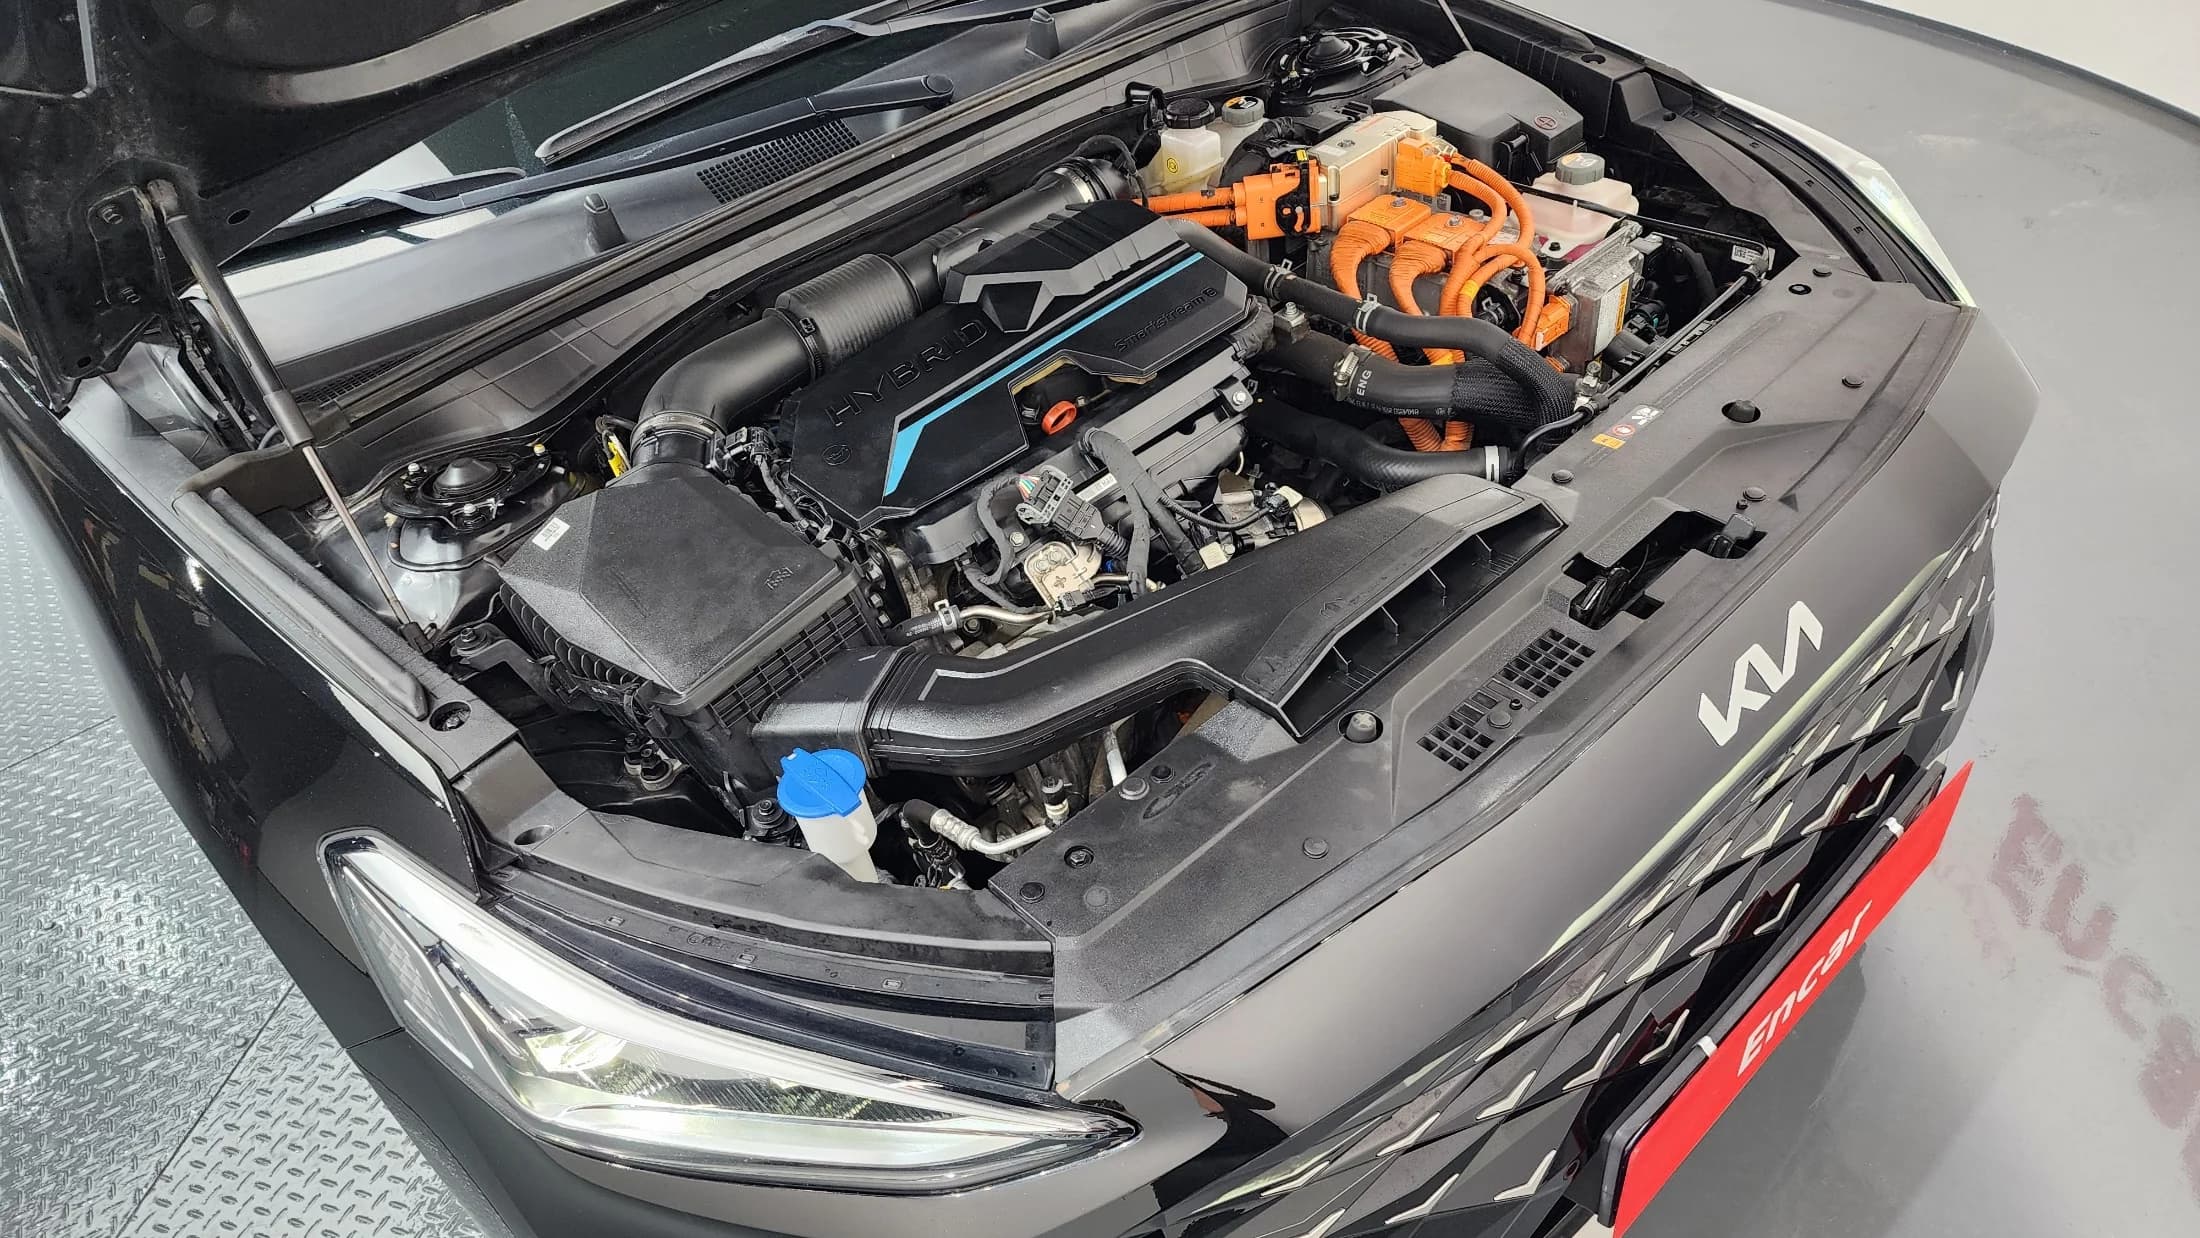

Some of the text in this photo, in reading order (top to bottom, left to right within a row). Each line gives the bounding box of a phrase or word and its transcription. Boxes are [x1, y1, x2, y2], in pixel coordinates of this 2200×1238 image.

[824, 319, 988, 427] HYBRID
[1356, 369, 1373, 396] ENG
[1698, 600, 1824, 747] KIA
[1737, 899, 1873, 1077] Encar
